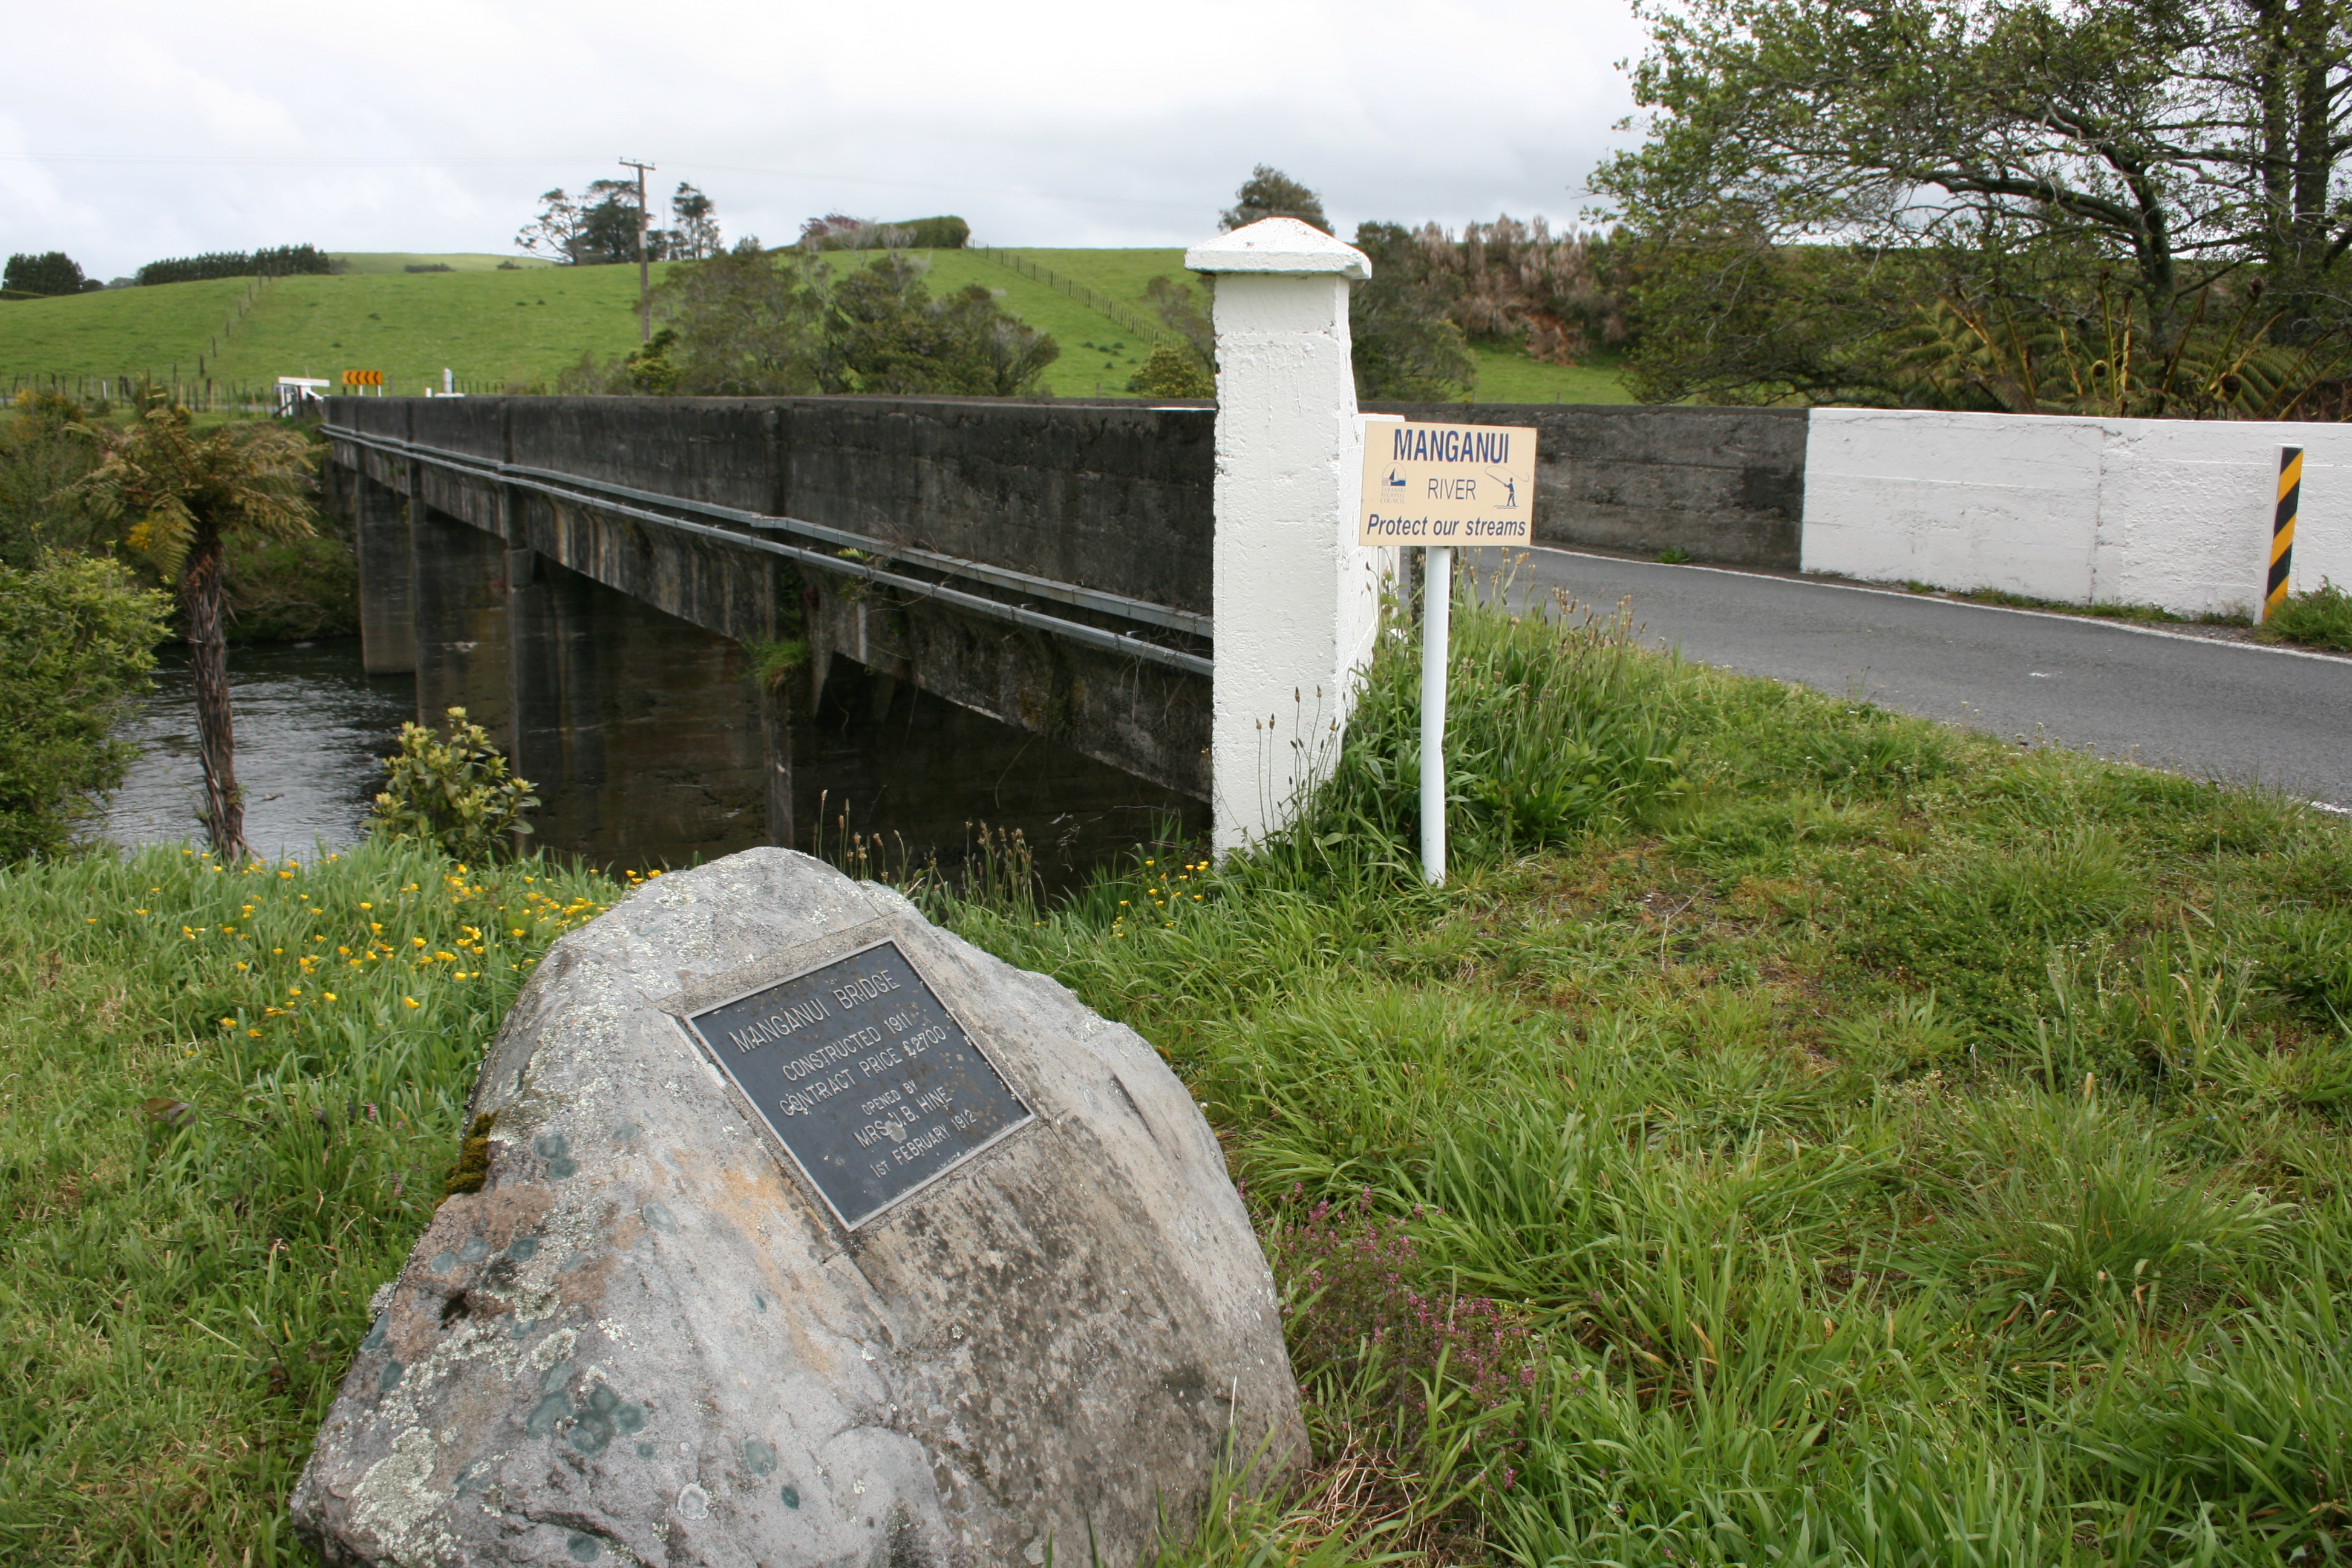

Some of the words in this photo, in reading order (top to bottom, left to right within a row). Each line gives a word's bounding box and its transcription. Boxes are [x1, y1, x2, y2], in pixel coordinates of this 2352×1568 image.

[1393, 428, 1509, 463] MANGANUI
[1428, 479, 1476, 500] RIVER
[1367, 514, 1428, 535] Protect
[1433, 520, 1459, 535] our
[1465, 517, 1526, 536] streams
[728, 999, 832, 1053] MANGANUI
[832, 969, 901, 1010] BRIDGE
[783, 1027, 881, 1082] CONSTRUCTED
[884, 1011, 912, 1036] 1911
[779, 1068, 856, 1117] CONTRACT
[860, 1048, 903, 1079] PRICE
[903, 1026, 947, 1058] £2700
[861, 1089, 901, 1116] OPENED
[903, 1080, 918, 1094] BY
[916, 1086, 953, 1114] HINE
[870, 1160, 890, 1178] 1ST
[892, 1124, 950, 1165] FEBRUARY
[950, 1109, 976, 1131] 1912
